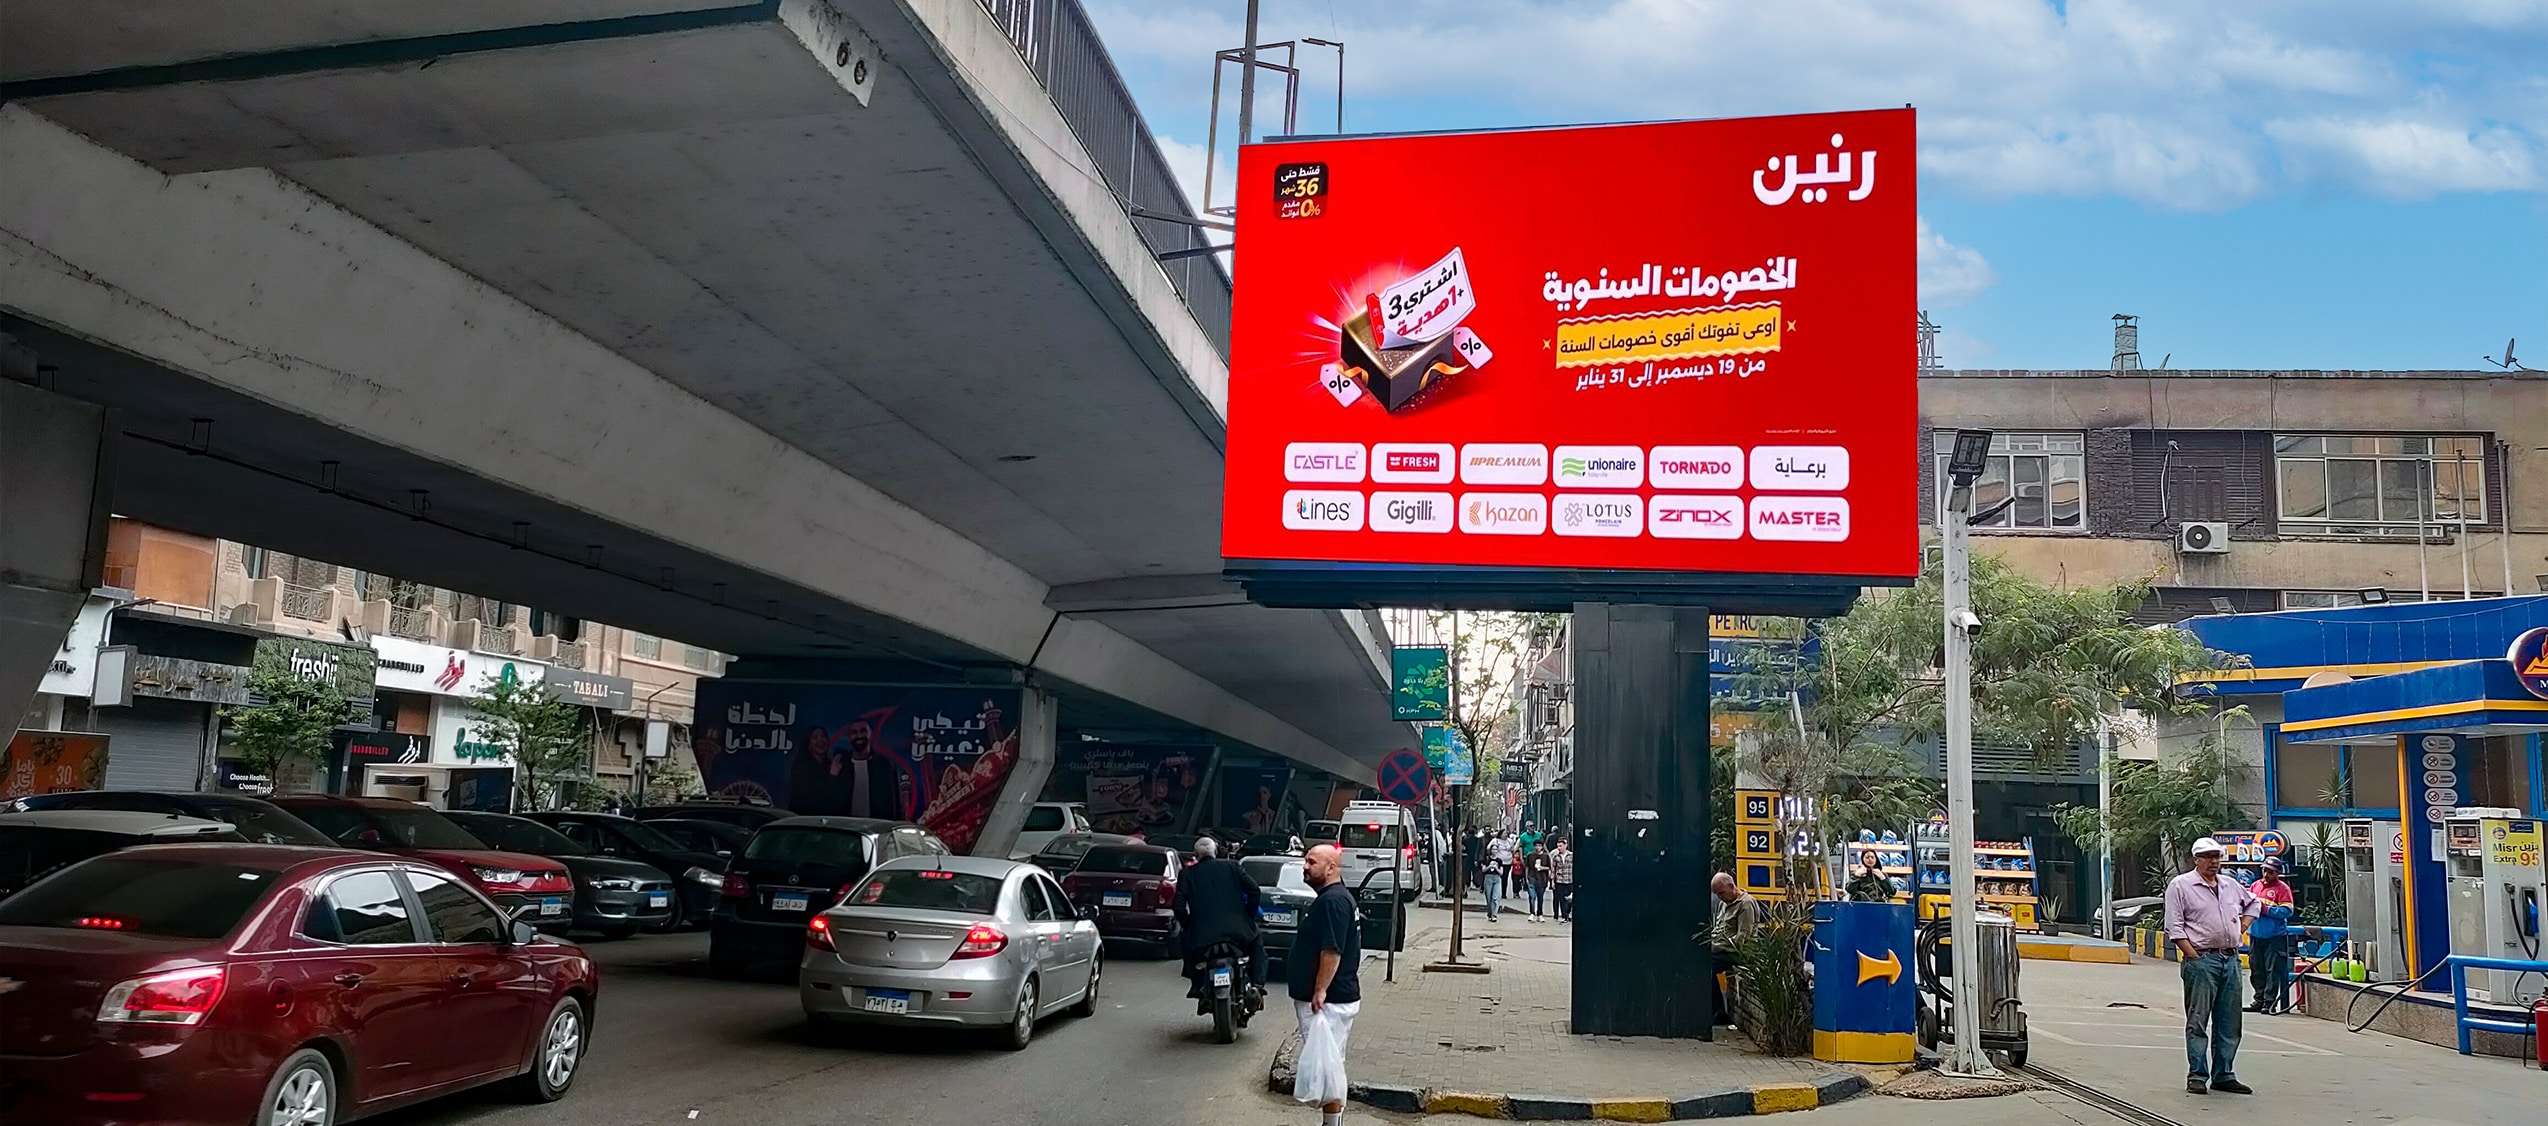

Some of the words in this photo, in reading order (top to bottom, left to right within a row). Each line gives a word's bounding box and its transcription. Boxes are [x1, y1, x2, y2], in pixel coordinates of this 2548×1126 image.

[1753, 133, 1877, 206] رنين
[1294, 177, 1319, 197] 36
[1403, 260, 1458, 316] اشتري
[1543, 262, 1662, 312] السنوية
[1664, 255, 1797, 303] الخصومات
[1598, 330, 1656, 352] خصومات
[1660, 322, 1694, 348] أقوى
[1698, 322, 1740, 345] تفوتك
[1560, 336, 1595, 354] السنة
[1609, 368, 1625, 384] 31
[1628, 362, 1653, 388] إلى
[1655, 364, 1714, 385] ديسمبر
[1718, 359, 1735, 374] 19
[1738, 357, 1766, 378] من
[1575, 368, 1605, 391] يناير
[1294, 454, 1356, 470] CASTLE
[1402, 456, 1437, 467] FRESH
[1588, 457, 1636, 471] unionaire
[1659, 461, 1732, 475] TORNADO
[1775, 457, 1826, 478] برعاية
[1299, 498, 1350, 521] Lines
[1387, 500, 1433, 525] Gigilli
[1586, 503, 1632, 518] LOTUS
[1759, 511, 1841, 526] MASTER
[573, 680, 609, 698] TABALI
[727, 701, 797, 726] لحظة
[912, 711, 986, 735] تيجي
[725, 728, 793, 755] بالدنيا
[911, 734, 985, 762] نعيش
[56, 765, 73, 785] 30
[1749, 801, 1767, 814] 95
[1750, 835, 1767, 848] 92
[2493, 843, 2517, 852] Misr
[2493, 855, 2517, 865] Extra
[2520, 852, 2540, 867] 95
